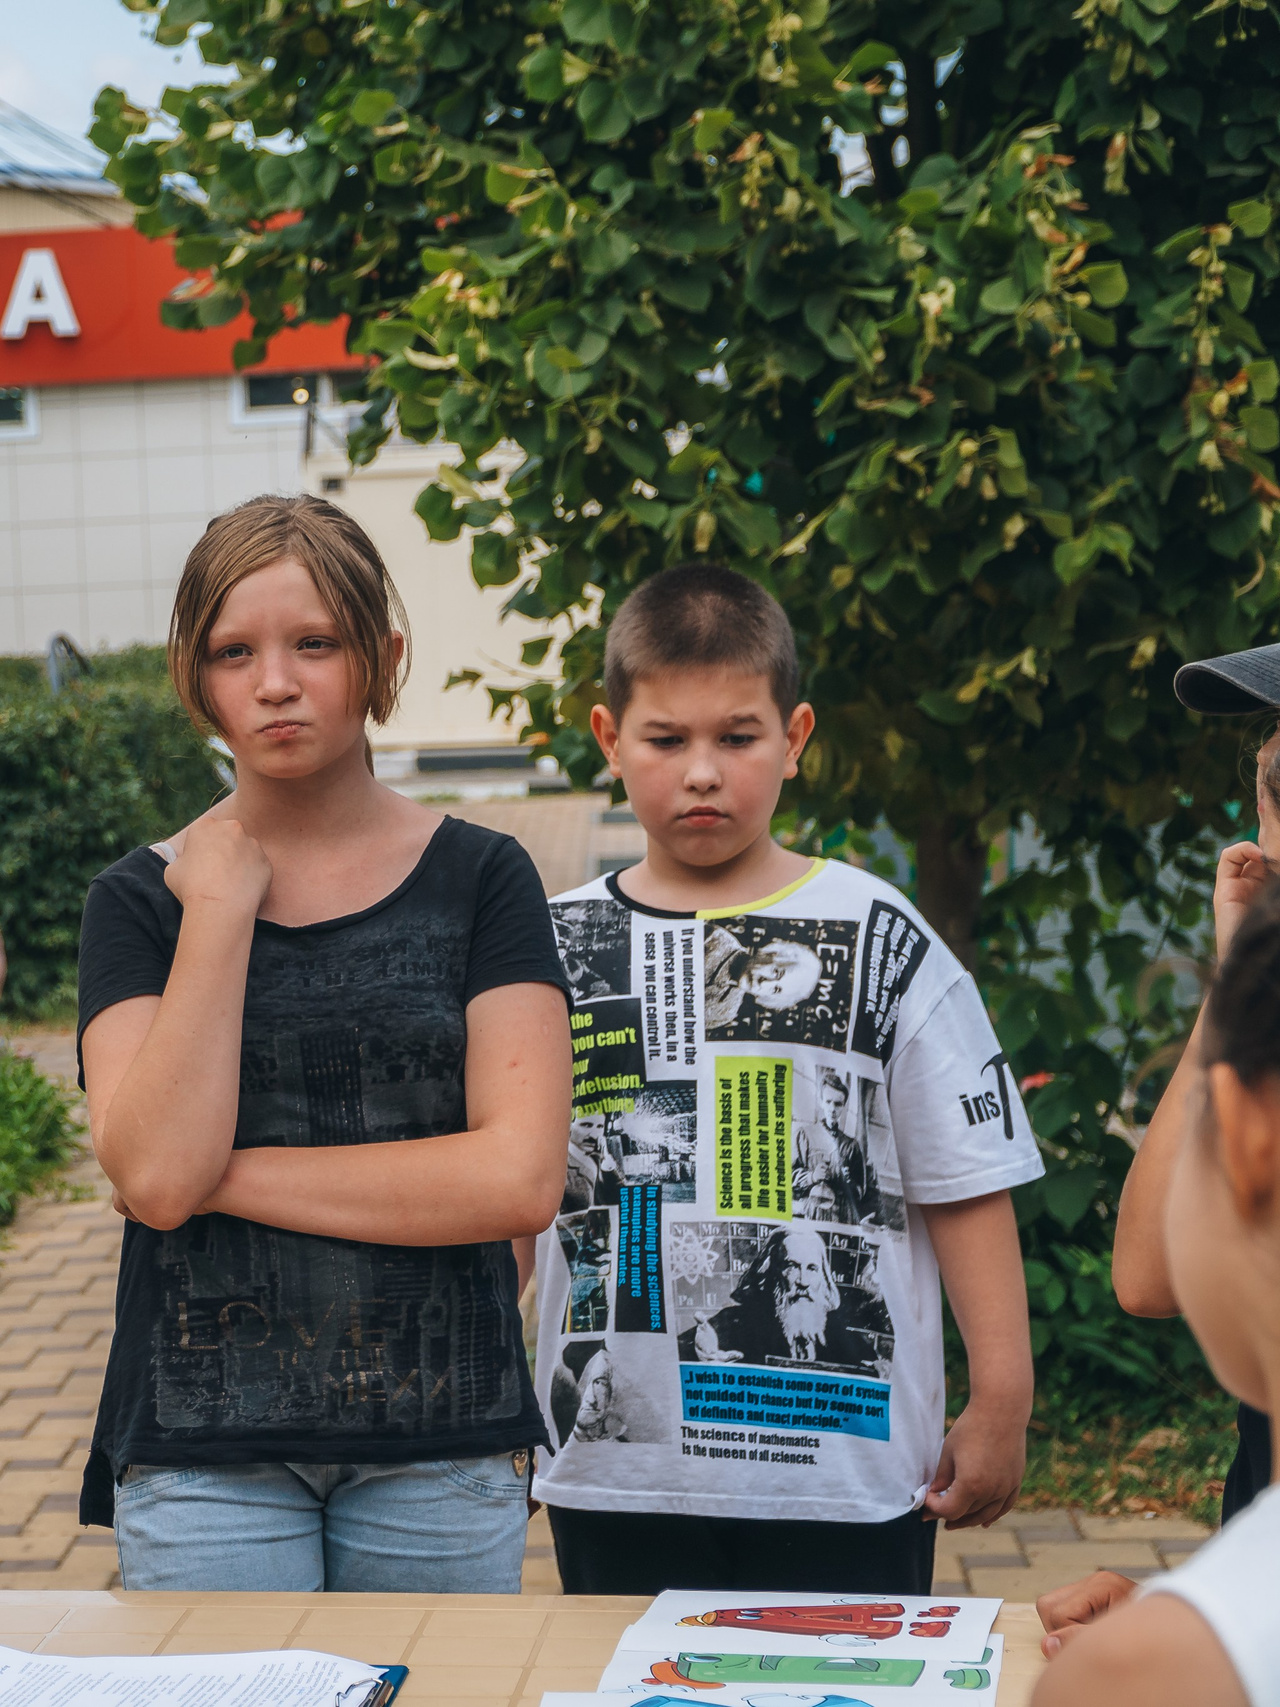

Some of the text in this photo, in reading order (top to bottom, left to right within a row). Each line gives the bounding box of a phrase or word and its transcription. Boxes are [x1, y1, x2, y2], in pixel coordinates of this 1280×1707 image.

[663, 931, 676, 973] universe
[867, 936, 885, 1003] understand
[644, 932, 661, 1061] sense you can control it.
[664, 975, 677, 1006] works
[681, 928, 697, 1065] If you understand how the
[570, 1012, 593, 1030] the
[572, 1027, 637, 1054] you can't
[666, 1041, 679, 1052] in
[580, 1073, 644, 1096] delusion.
[576, 1096, 634, 1119] anything
[719, 1078, 733, 1209] Science is the basis of
[738, 1072, 753, 1209] all progress that makes
[755, 1070, 770, 1208] life easier for humanity
[773, 1064, 787, 1212] and reduces its suffering
[646, 1186, 658, 1198] In
[618, 1188, 630, 1287] useful than rules.
[645, 1200, 659, 1251] studying
[702, 1224, 720, 1235] Mo
[631, 1187, 642, 1297] examples are more
[831, 1235, 848, 1249] Ag
[647, 1254, 659, 1272] the
[696, 1371, 720, 1385] wish
[722, 1372, 735, 1385] to
[737, 1374, 784, 1390] establish
[785, 1378, 813, 1392] some
[815, 1381, 839, 1396] sort
[841, 1383, 853, 1396] of
[855, 1385, 890, 1401] system
[686, 1389, 884, 1418] not guided by chance but by some sort
[689, 1405, 699, 1418] of
[701, 1406, 744, 1420] definite
[747, 1410, 764, 1422] and
[766, 1412, 790, 1425] exact
[681, 1426, 820, 1448] The science of mathematics
[682, 1442, 818, 1466] is the queen of all sciences.
